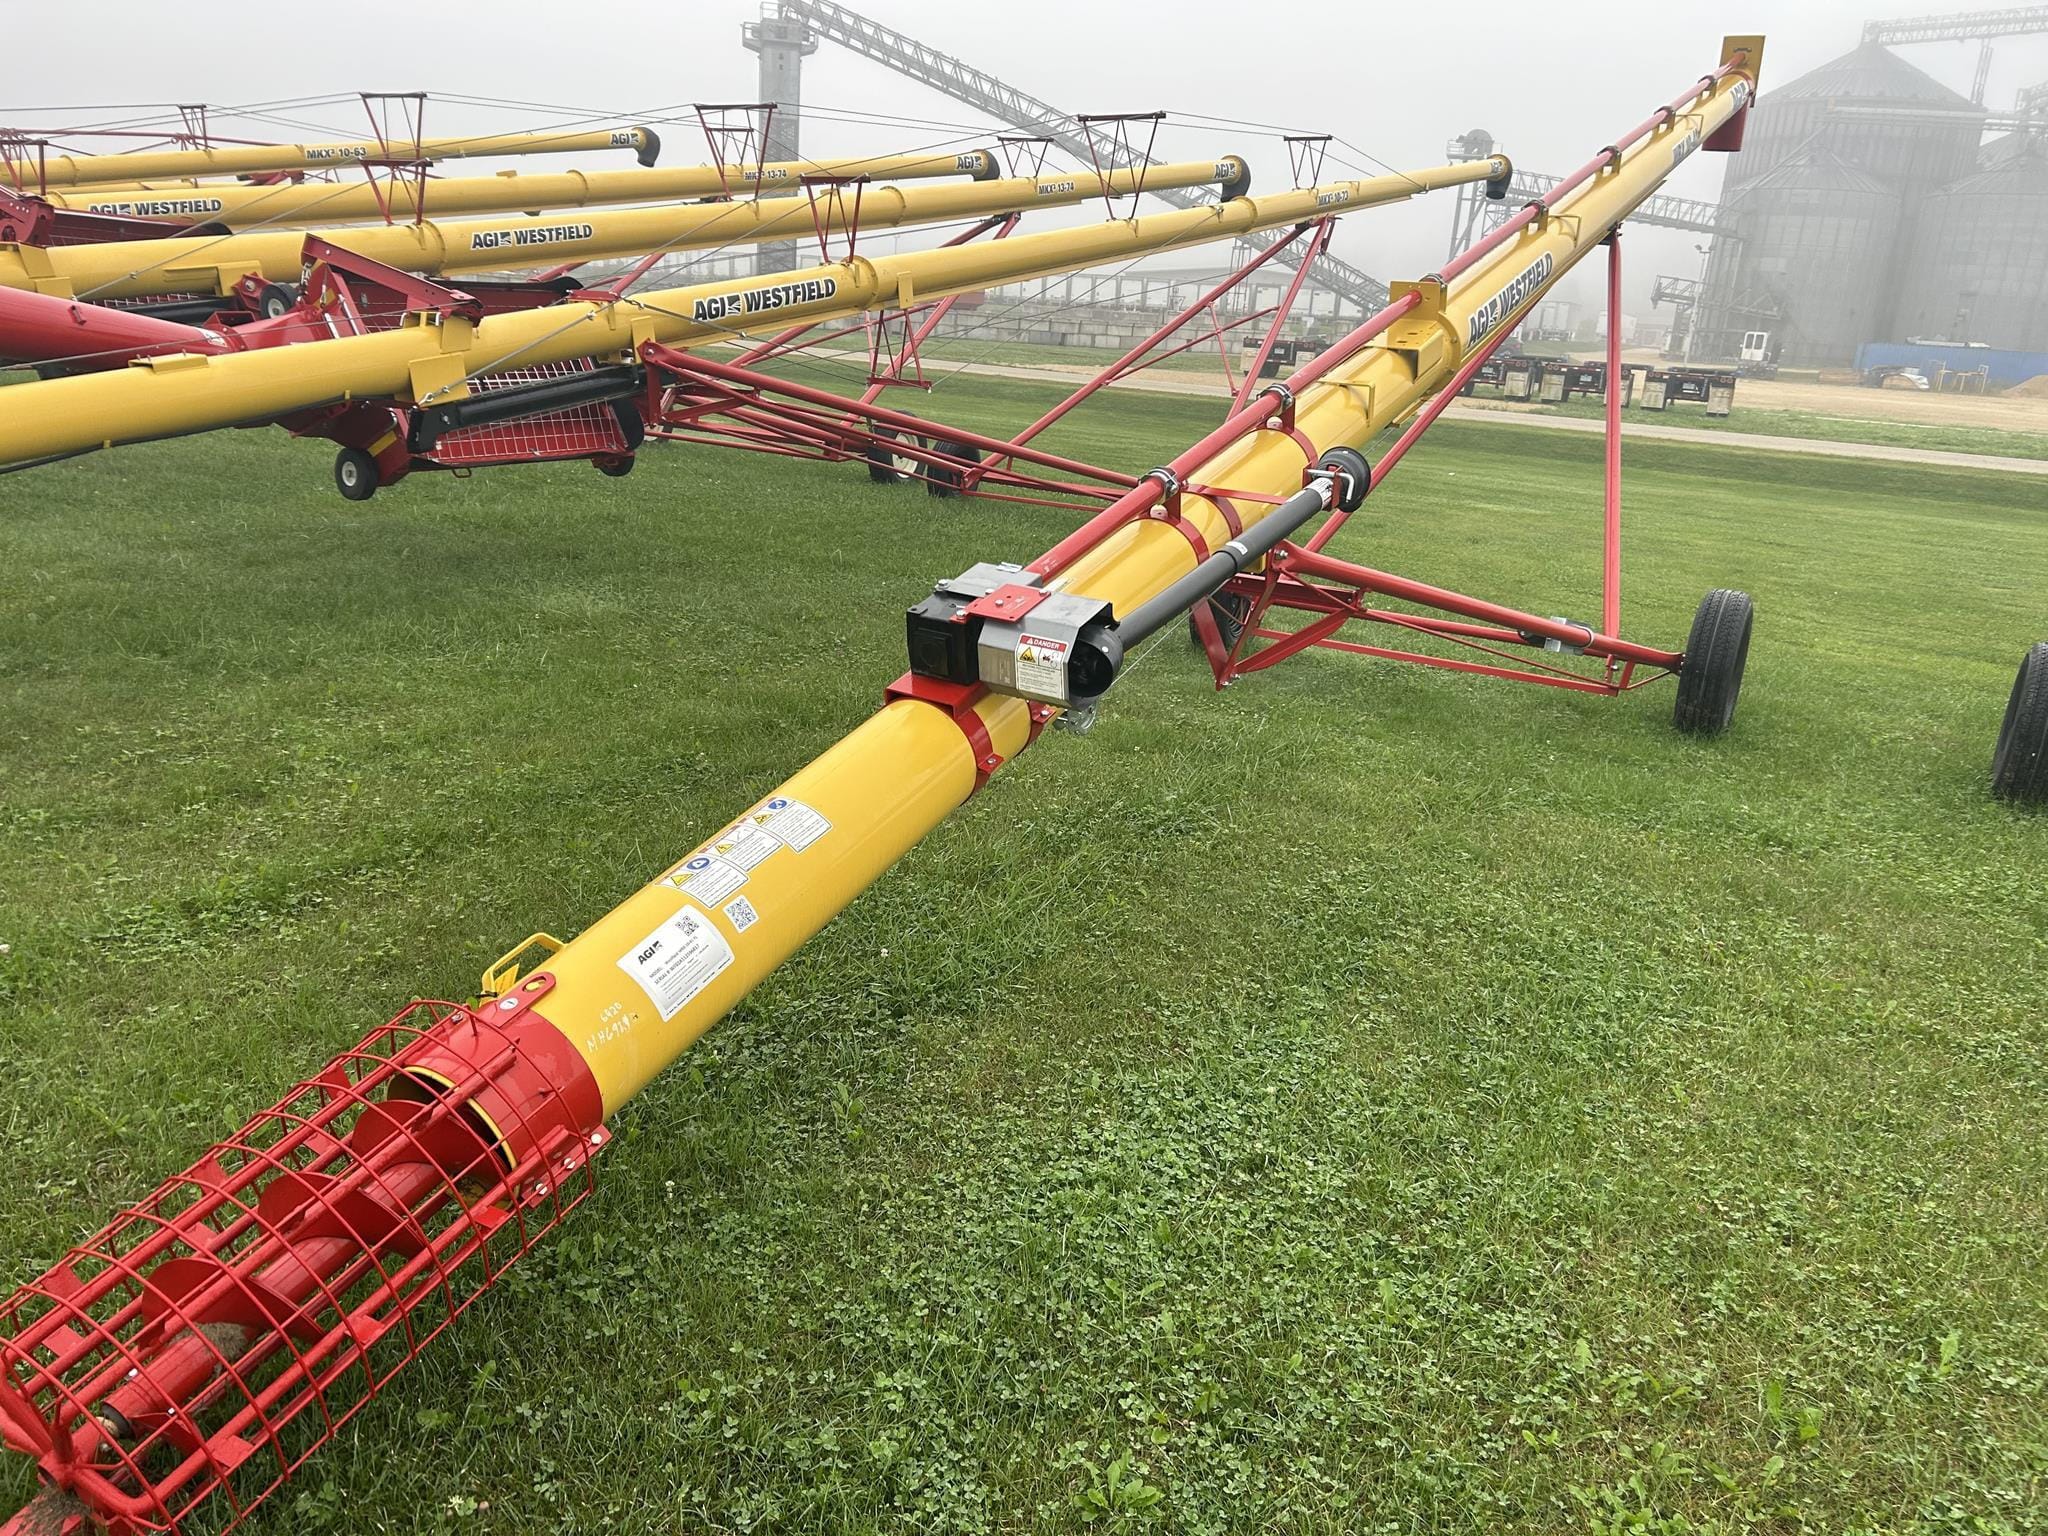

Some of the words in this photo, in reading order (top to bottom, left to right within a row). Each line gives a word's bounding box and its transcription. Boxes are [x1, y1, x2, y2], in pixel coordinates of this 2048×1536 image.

[610, 134, 630, 145] AGI
[338, 147, 367, 158] 10-63
[956, 156, 974, 170] AGI
[1215, 163, 1230, 179] AGI
[767, 169, 787, 179] 13-74
[134, 200, 222, 216] WESTFIELD
[471, 232, 499, 249] AGI
[513, 224, 593, 245] WESTFIELD
[694, 297, 726, 321] AGI
[744, 278, 836, 313] WESTFIELD
[1466, 306, 1489, 349] AGI
[1498, 252, 1553, 320] WESTFIELD
[1033, 639, 1060, 650] DANGER
[637, 946, 656, 965] AGI
